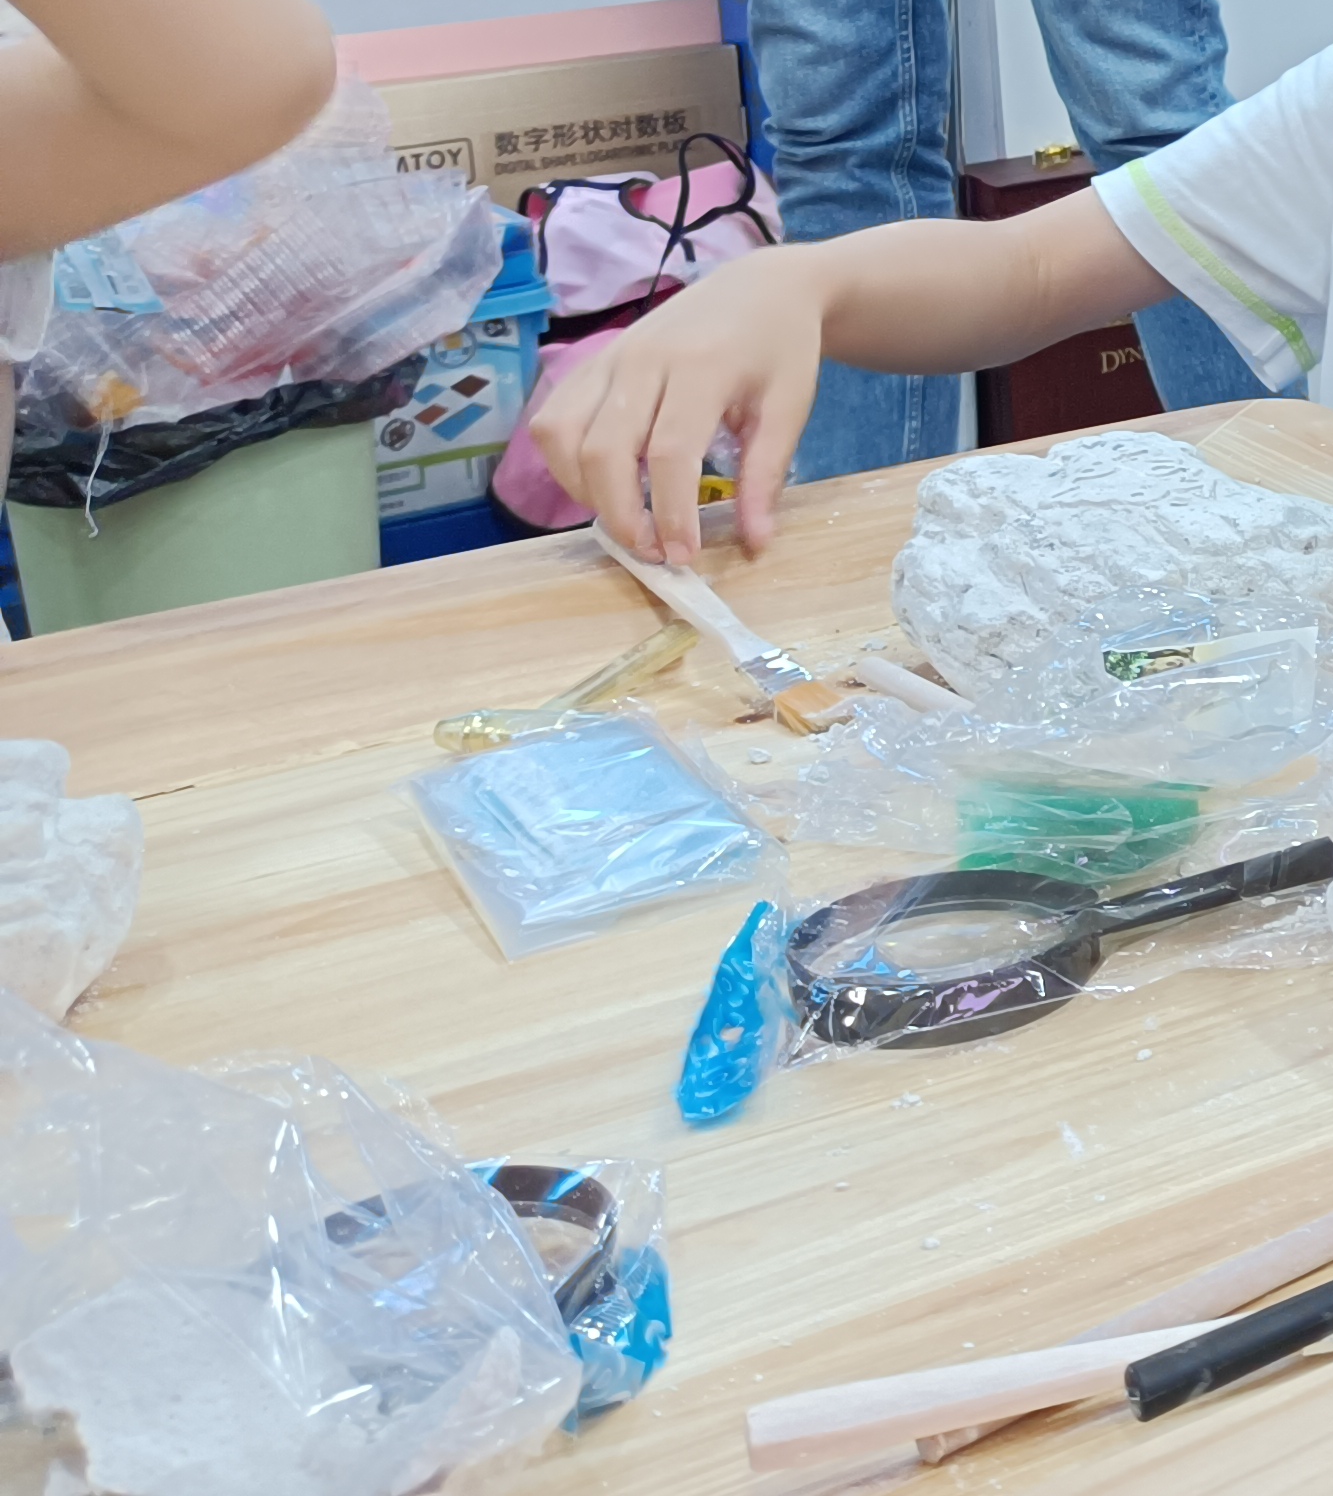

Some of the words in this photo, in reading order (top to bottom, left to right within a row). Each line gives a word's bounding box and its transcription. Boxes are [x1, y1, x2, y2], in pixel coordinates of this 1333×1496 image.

[495, 109, 688, 157] 数字形状对数板
